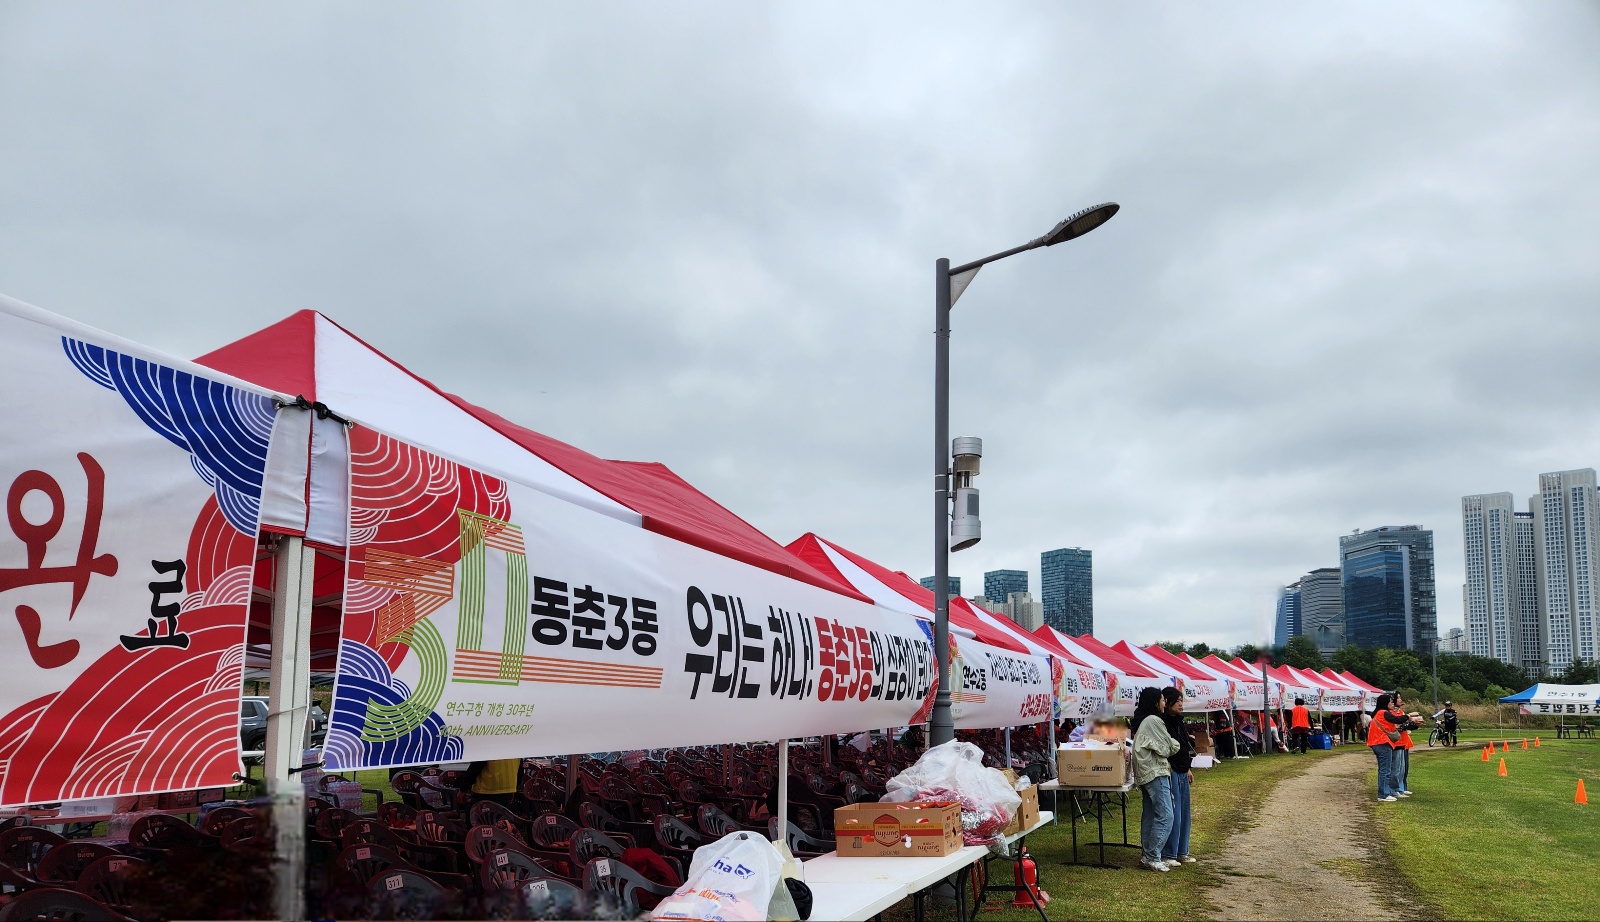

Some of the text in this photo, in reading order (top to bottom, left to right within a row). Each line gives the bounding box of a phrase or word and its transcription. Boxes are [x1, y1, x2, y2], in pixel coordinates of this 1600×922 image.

[531, 576, 658, 656] 동춘3동
[685, 586, 764, 699] 우리는
[767, 605, 813, 700] 하나!
[814, 616, 885, 701] 동춘3동의
[963, 665, 986, 691] 연수2동
[446, 702, 535, 717] 연수구청 개청 30주년
[436, 725, 533, 737] 30th ANNIVERSARY
